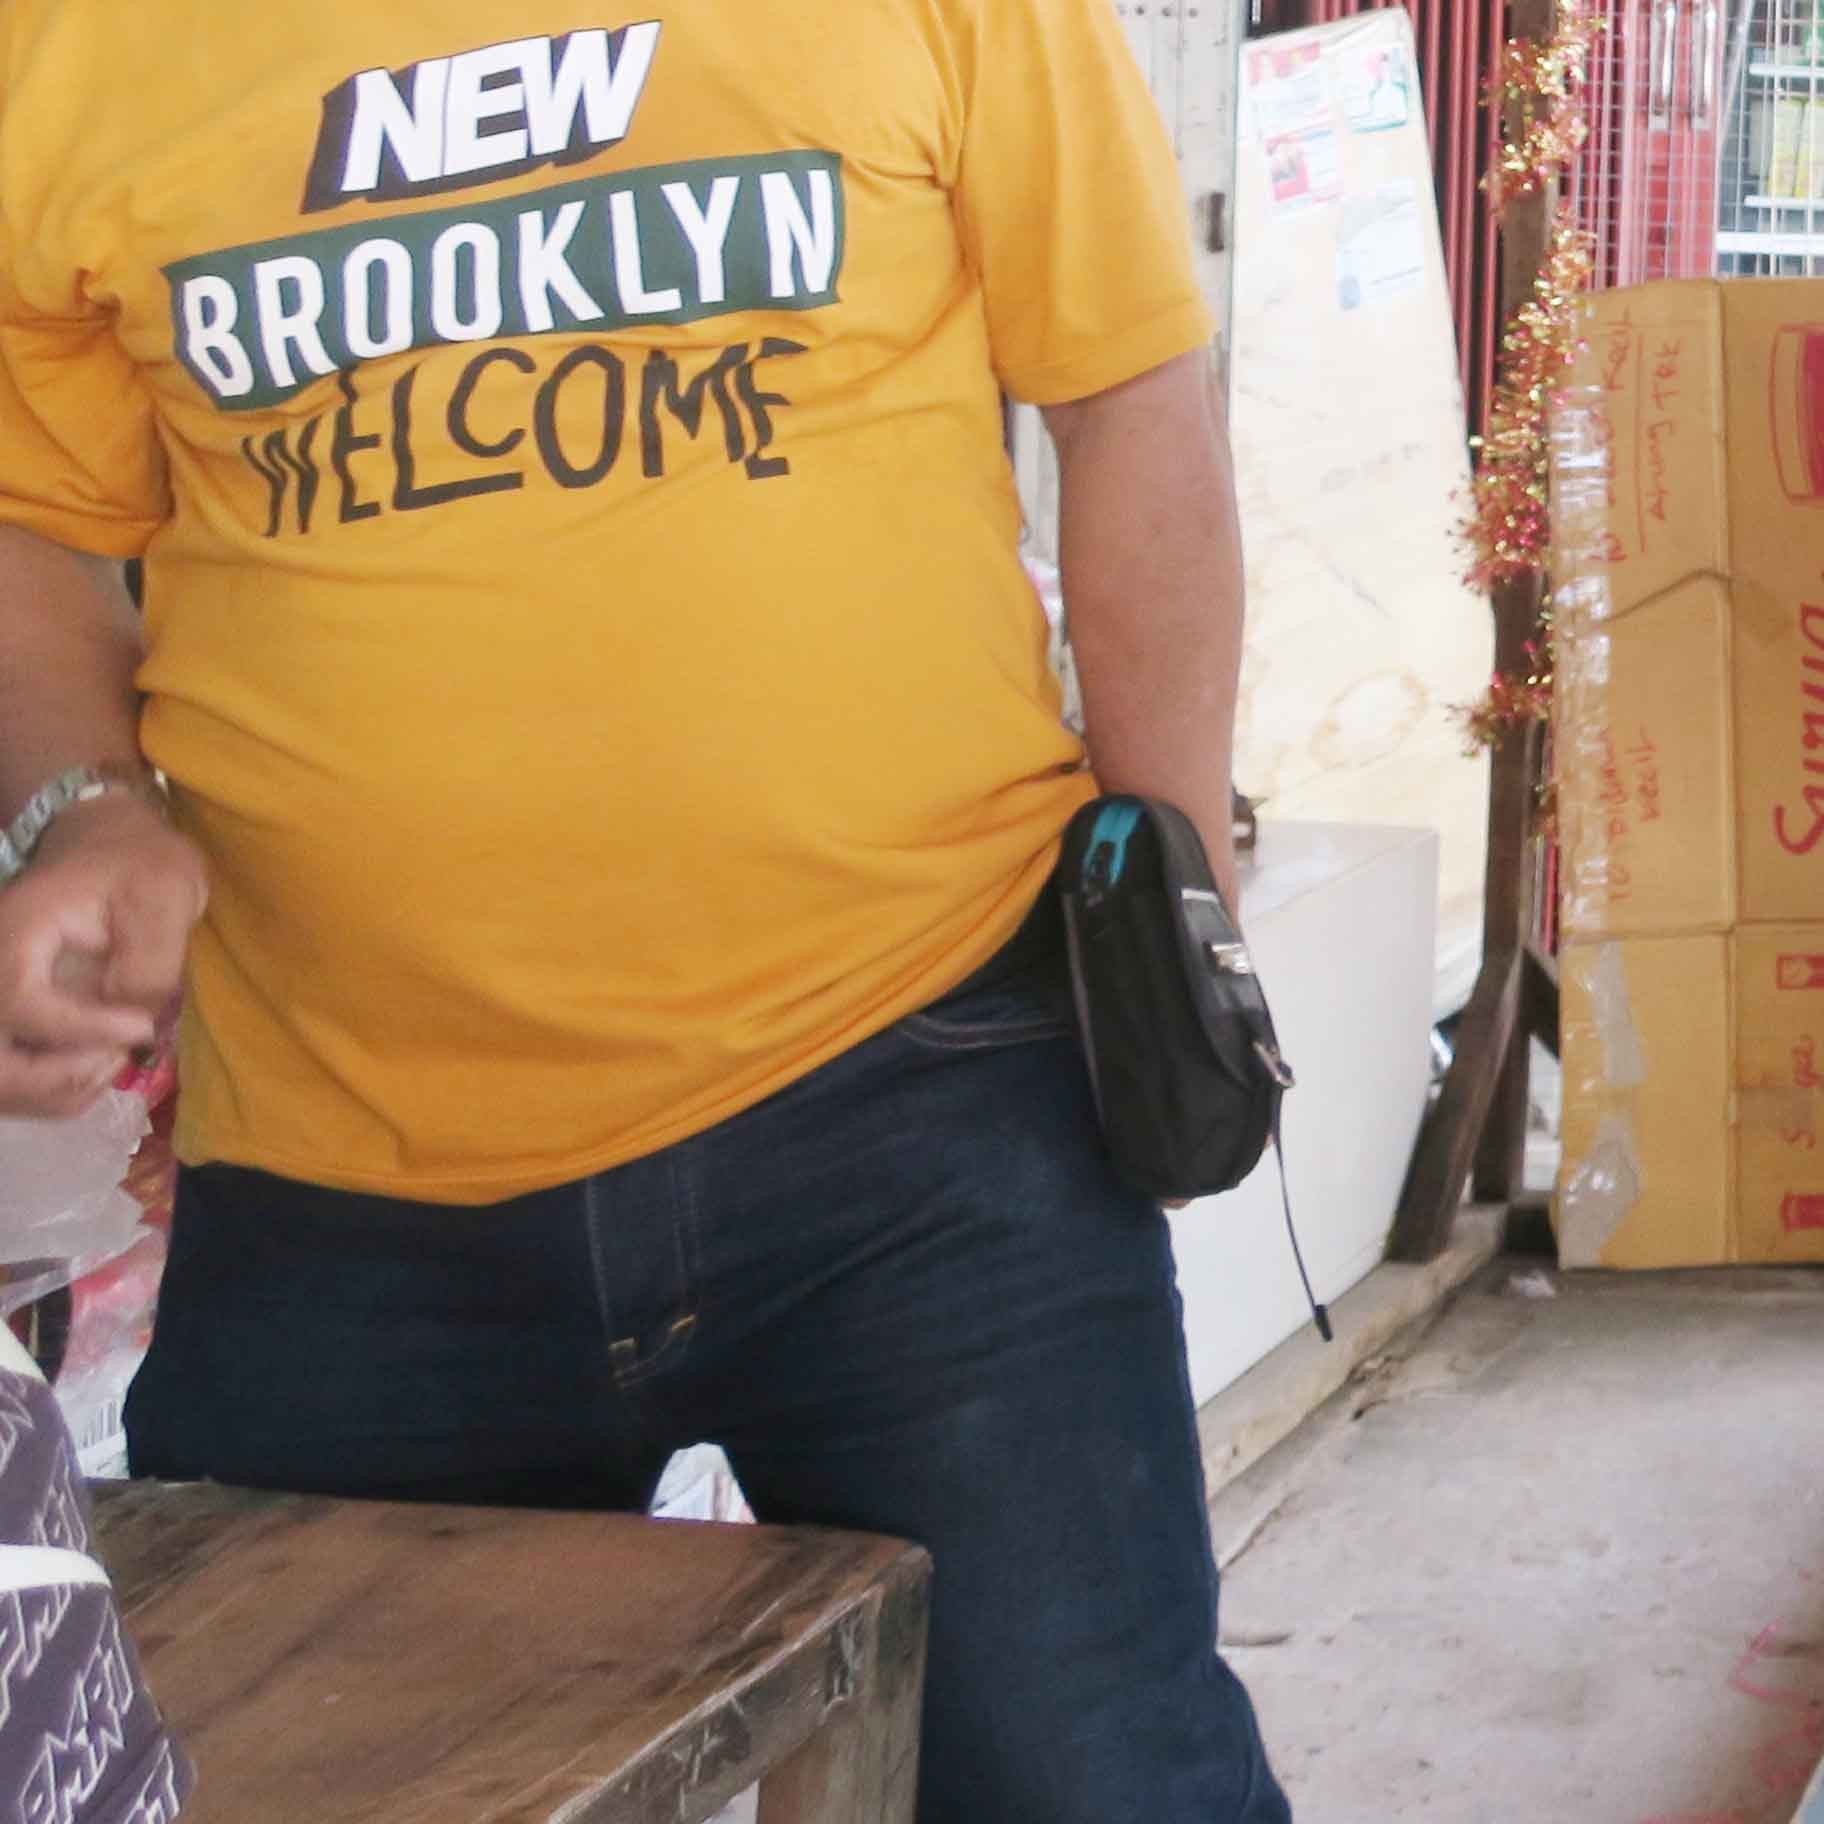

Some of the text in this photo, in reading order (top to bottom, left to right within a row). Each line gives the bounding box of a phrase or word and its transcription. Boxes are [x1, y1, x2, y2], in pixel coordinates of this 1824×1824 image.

[303, 20, 662, 213] NEW
[181, 168, 836, 398] BROOKLYN
[242, 337, 808, 538] WELCOME
